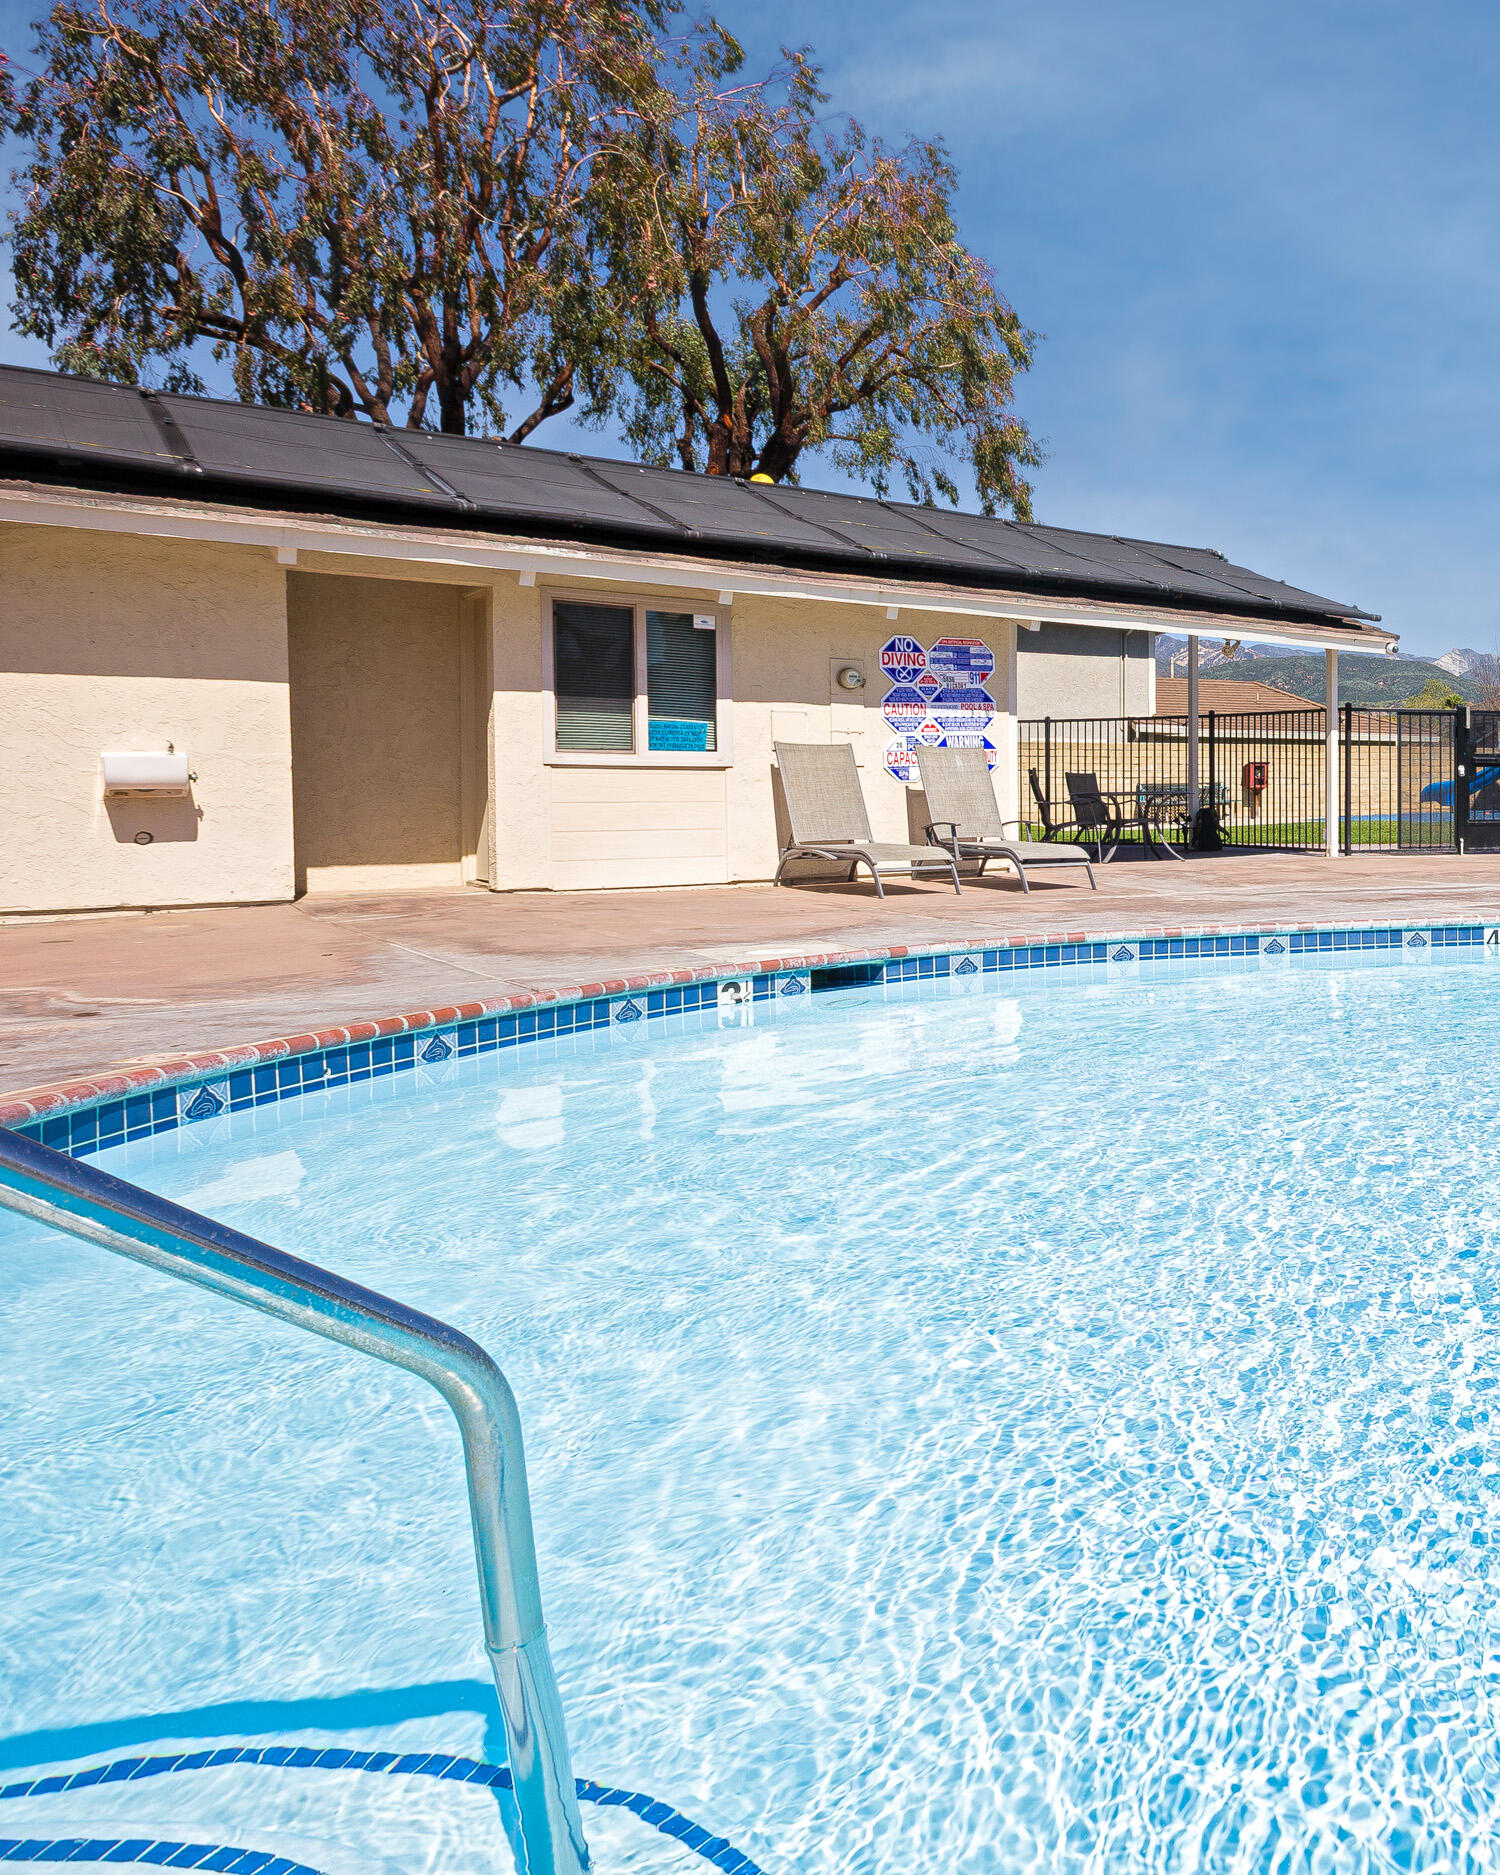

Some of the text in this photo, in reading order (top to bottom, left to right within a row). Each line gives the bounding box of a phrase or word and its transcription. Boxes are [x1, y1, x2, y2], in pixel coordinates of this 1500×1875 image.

[895, 638, 913, 651] NO
[881, 652, 926, 667] DIVING
[969, 671, 981, 685] 911
[883, 703, 927, 716] CAUTION
[960, 703, 977, 711] POOL
[983, 703, 995, 711] SPA
[945, 735, 985, 748] WARNING
[886, 751, 918, 766] CAPAC
